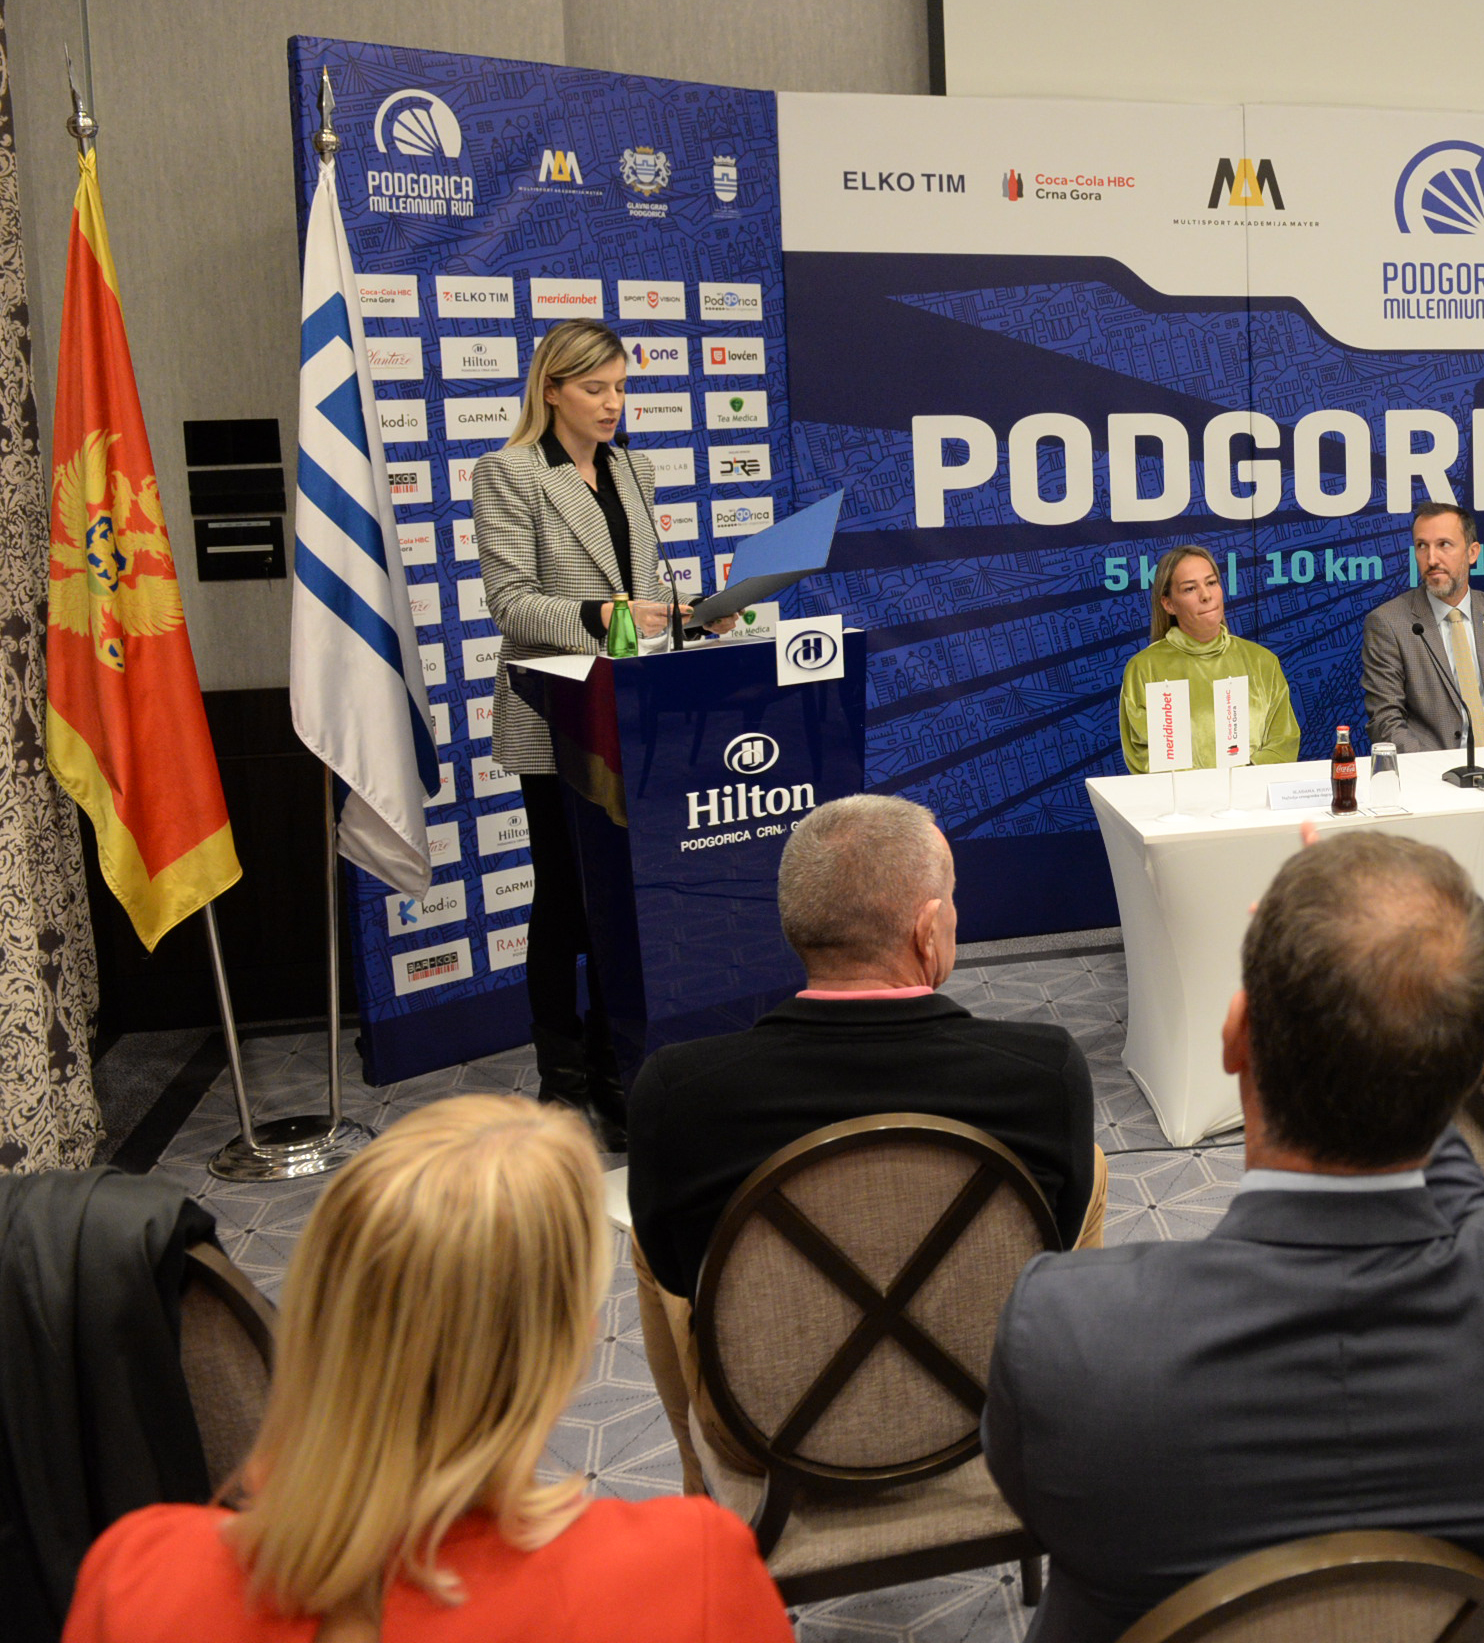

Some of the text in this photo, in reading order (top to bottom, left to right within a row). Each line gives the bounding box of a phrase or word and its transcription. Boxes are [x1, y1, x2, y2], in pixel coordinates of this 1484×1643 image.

[368, 171, 474, 200] PODGORICA
[843, 172, 966, 194] ELKO TIM
[1035, 173, 1135, 188] Coca-Cola HBC
[1036, 188, 1102, 201] Crna Gora
[370, 196, 474, 216] MILLENNIUM RUN
[650, 203, 668, 212] GRAD
[1173, 218, 1232, 226] MULTISPORT
[360, 288, 396, 296] Coca-Cola
[454, 292, 509, 303] ELKO TIM
[537, 294, 597, 305] meridianbet
[728, 350, 758, 361] lovćen
[462, 356, 498, 368] Hilton
[458, 413, 508, 423] GARMIN
[718, 414, 758, 422] Tea Medica
[1104, 557, 1129, 592] 5
[1266, 550, 1316, 585] 10
[1325, 549, 1382, 582] km
[731, 626, 770, 638] Tea Medica
[1162, 692, 1175, 760] meridianbet
[489, 770, 520, 780] ELK
[686, 783, 816, 830] Hilton
[680, 830, 752, 852] PODGORICA
[496, 880, 533, 896] GARMI
[496, 937, 528, 952] RAM
